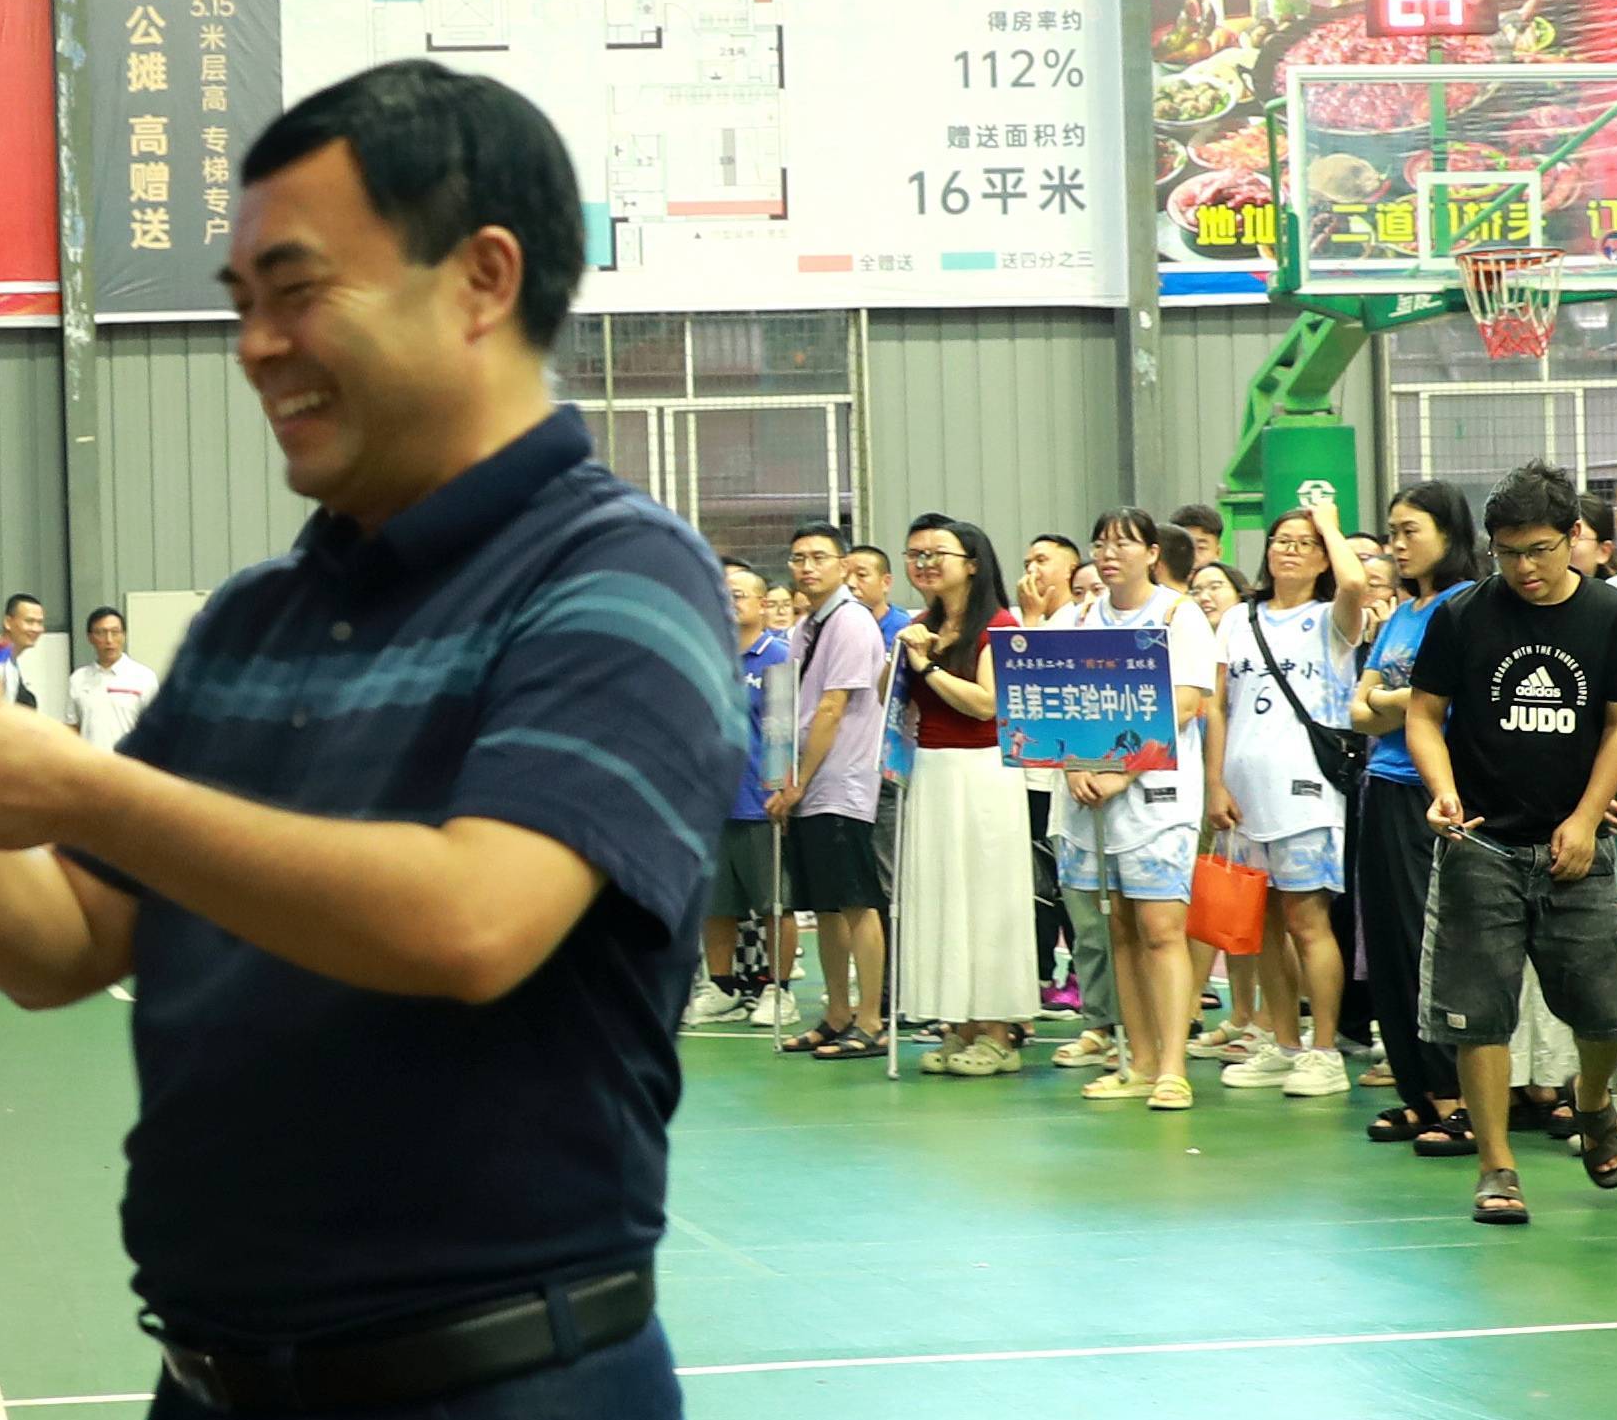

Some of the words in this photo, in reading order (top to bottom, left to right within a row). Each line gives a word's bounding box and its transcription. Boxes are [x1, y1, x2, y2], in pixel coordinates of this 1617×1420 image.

[987, 10, 1083, 32] 得房率约
[953, 48, 1085, 89] 112%
[946, 123, 1087, 150] 赠送面积约
[129, 115, 172, 251] 高赠送
[201, 126, 231, 245] 专梯专户
[907, 166, 1088, 216] 16平米
[1535, 644, 1553, 656] THE
[1007, 683, 1159, 722] 县第三实验中小学
[1254, 686, 1273, 715] 6
[1515, 684, 1562, 698] adidas
[1499, 705, 1576, 734] JUDO
